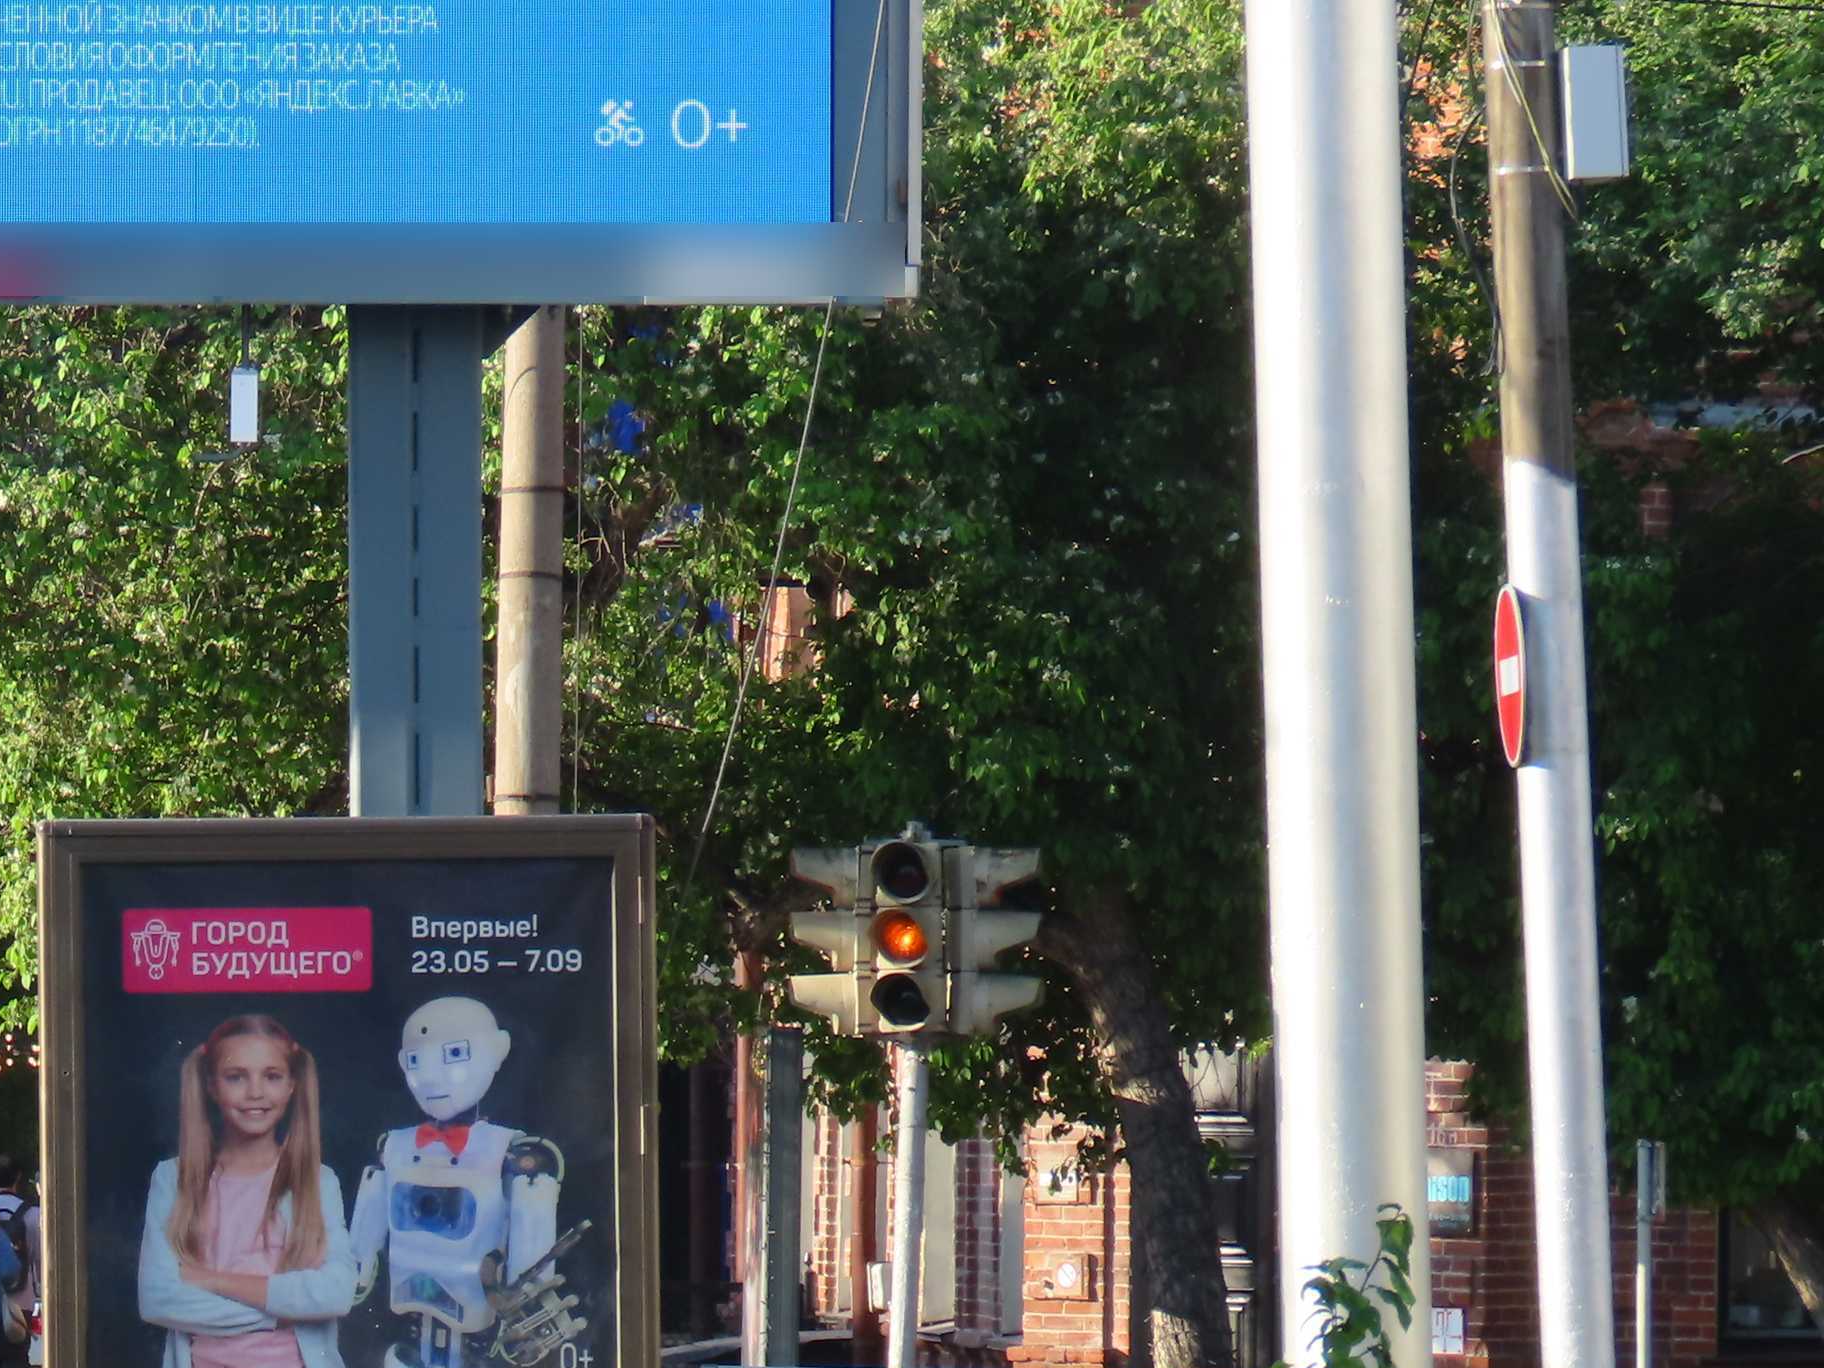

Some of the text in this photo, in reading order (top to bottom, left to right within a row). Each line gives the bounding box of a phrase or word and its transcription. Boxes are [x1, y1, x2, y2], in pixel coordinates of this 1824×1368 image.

[105, 5, 229, 33] ЗНАЧКОМ
[235, 5, 251, 33] В
[255, 5, 327, 37] ВИДЕ
[330, 5, 439, 33] КУРЬЕРА
[108, 42, 297, 71] ОФОРМЛЕНИЯ
[300, 42, 401, 71] ЗАКАЗА
[179, 80, 240, 109] ООО
[671, 99, 747, 148] 0+
[191, 920, 289, 947] ГОРОД
[411, 915, 539, 943] Впервые!
[411, 951, 490, 974] 23.05
[525, 950, 583, 973] 7.09
